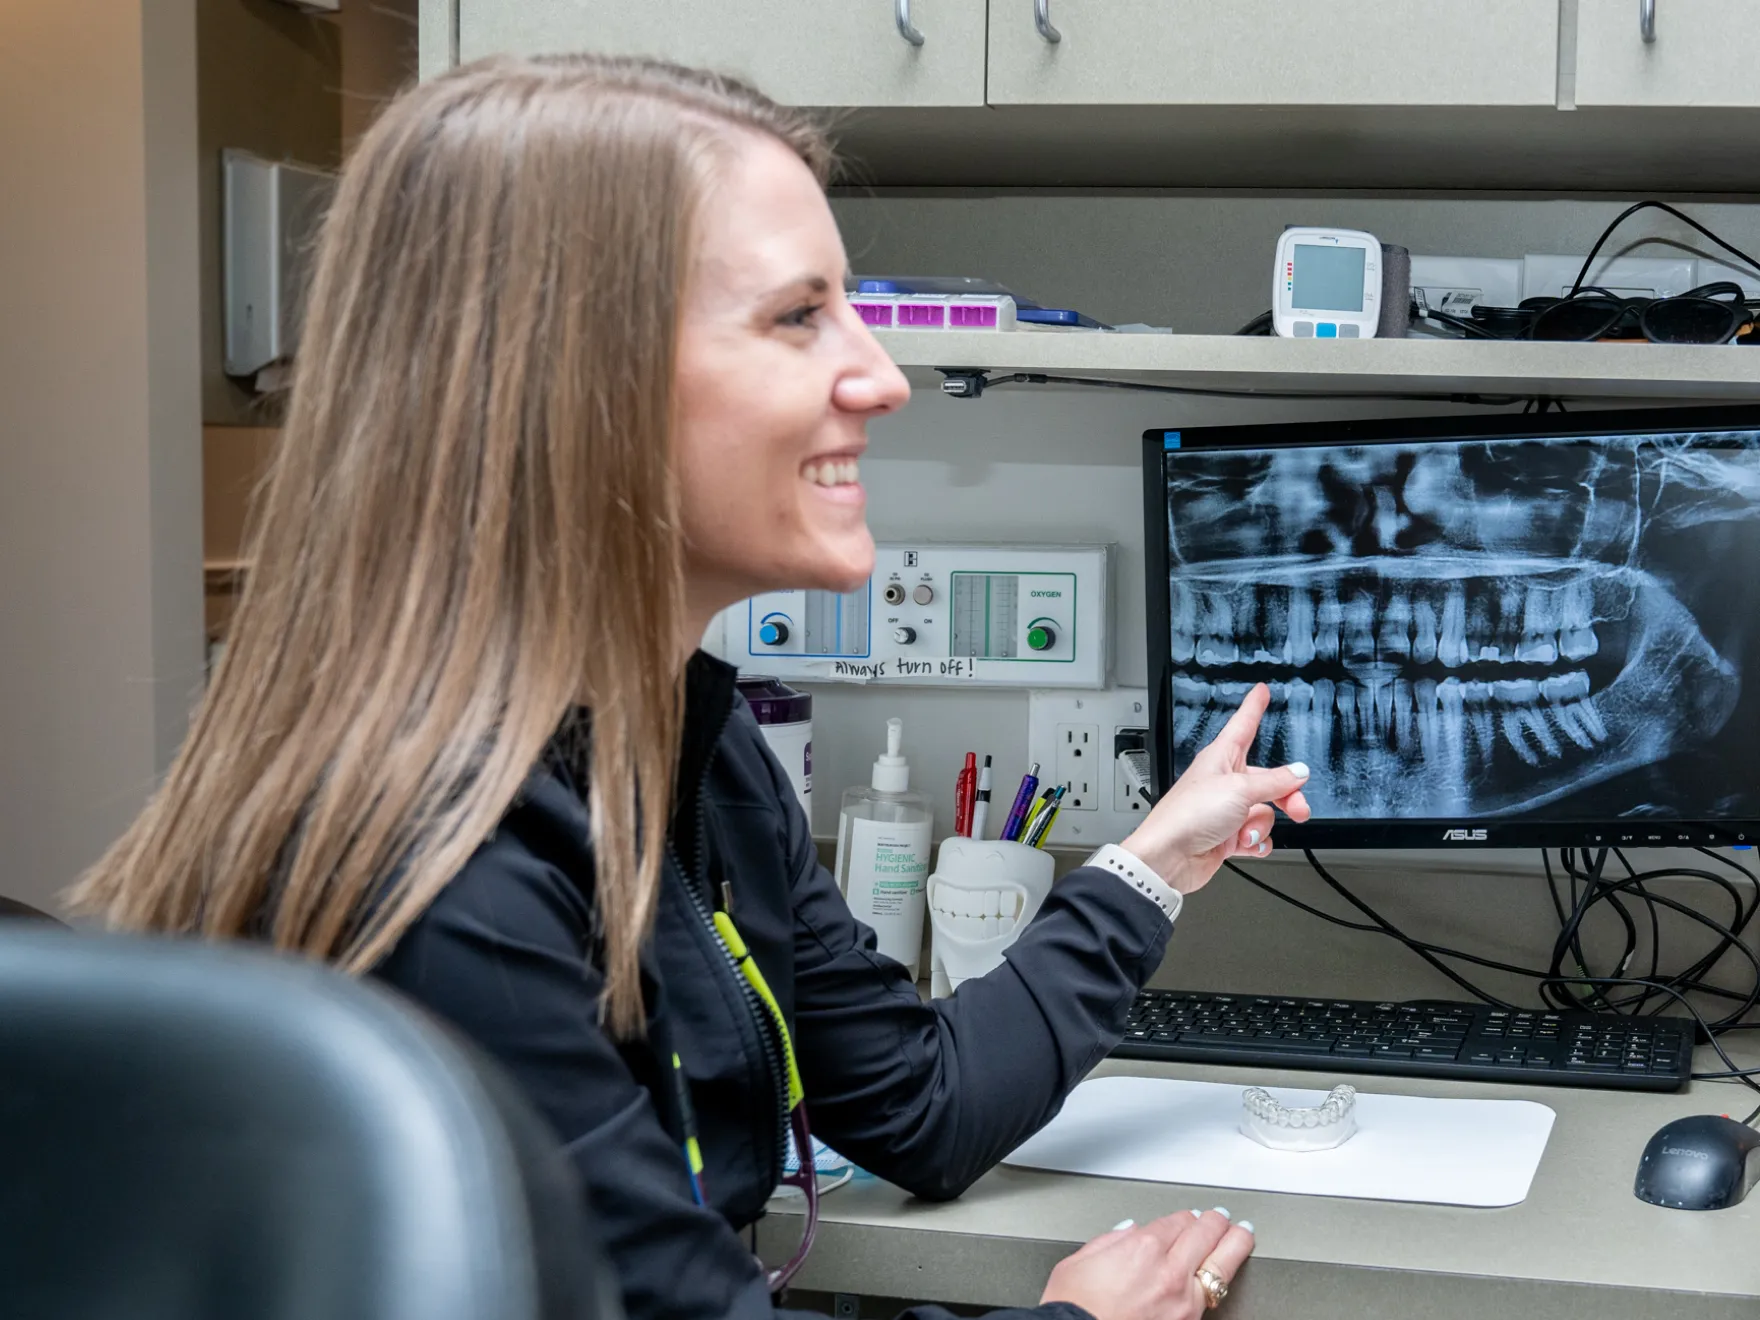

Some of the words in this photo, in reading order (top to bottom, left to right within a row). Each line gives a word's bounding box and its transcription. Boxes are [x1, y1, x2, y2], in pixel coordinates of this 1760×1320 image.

[1030, 590, 1062, 598] OXYGEN
[835, 660, 886, 678] Always
[897, 657, 932, 674] turn
[1442, 829, 1488, 840] ASUS
[876, 852, 916, 863] HYGIENIC
[874, 862, 899, 873] Hand
[1661, 1146, 1709, 1161] Lenovo
